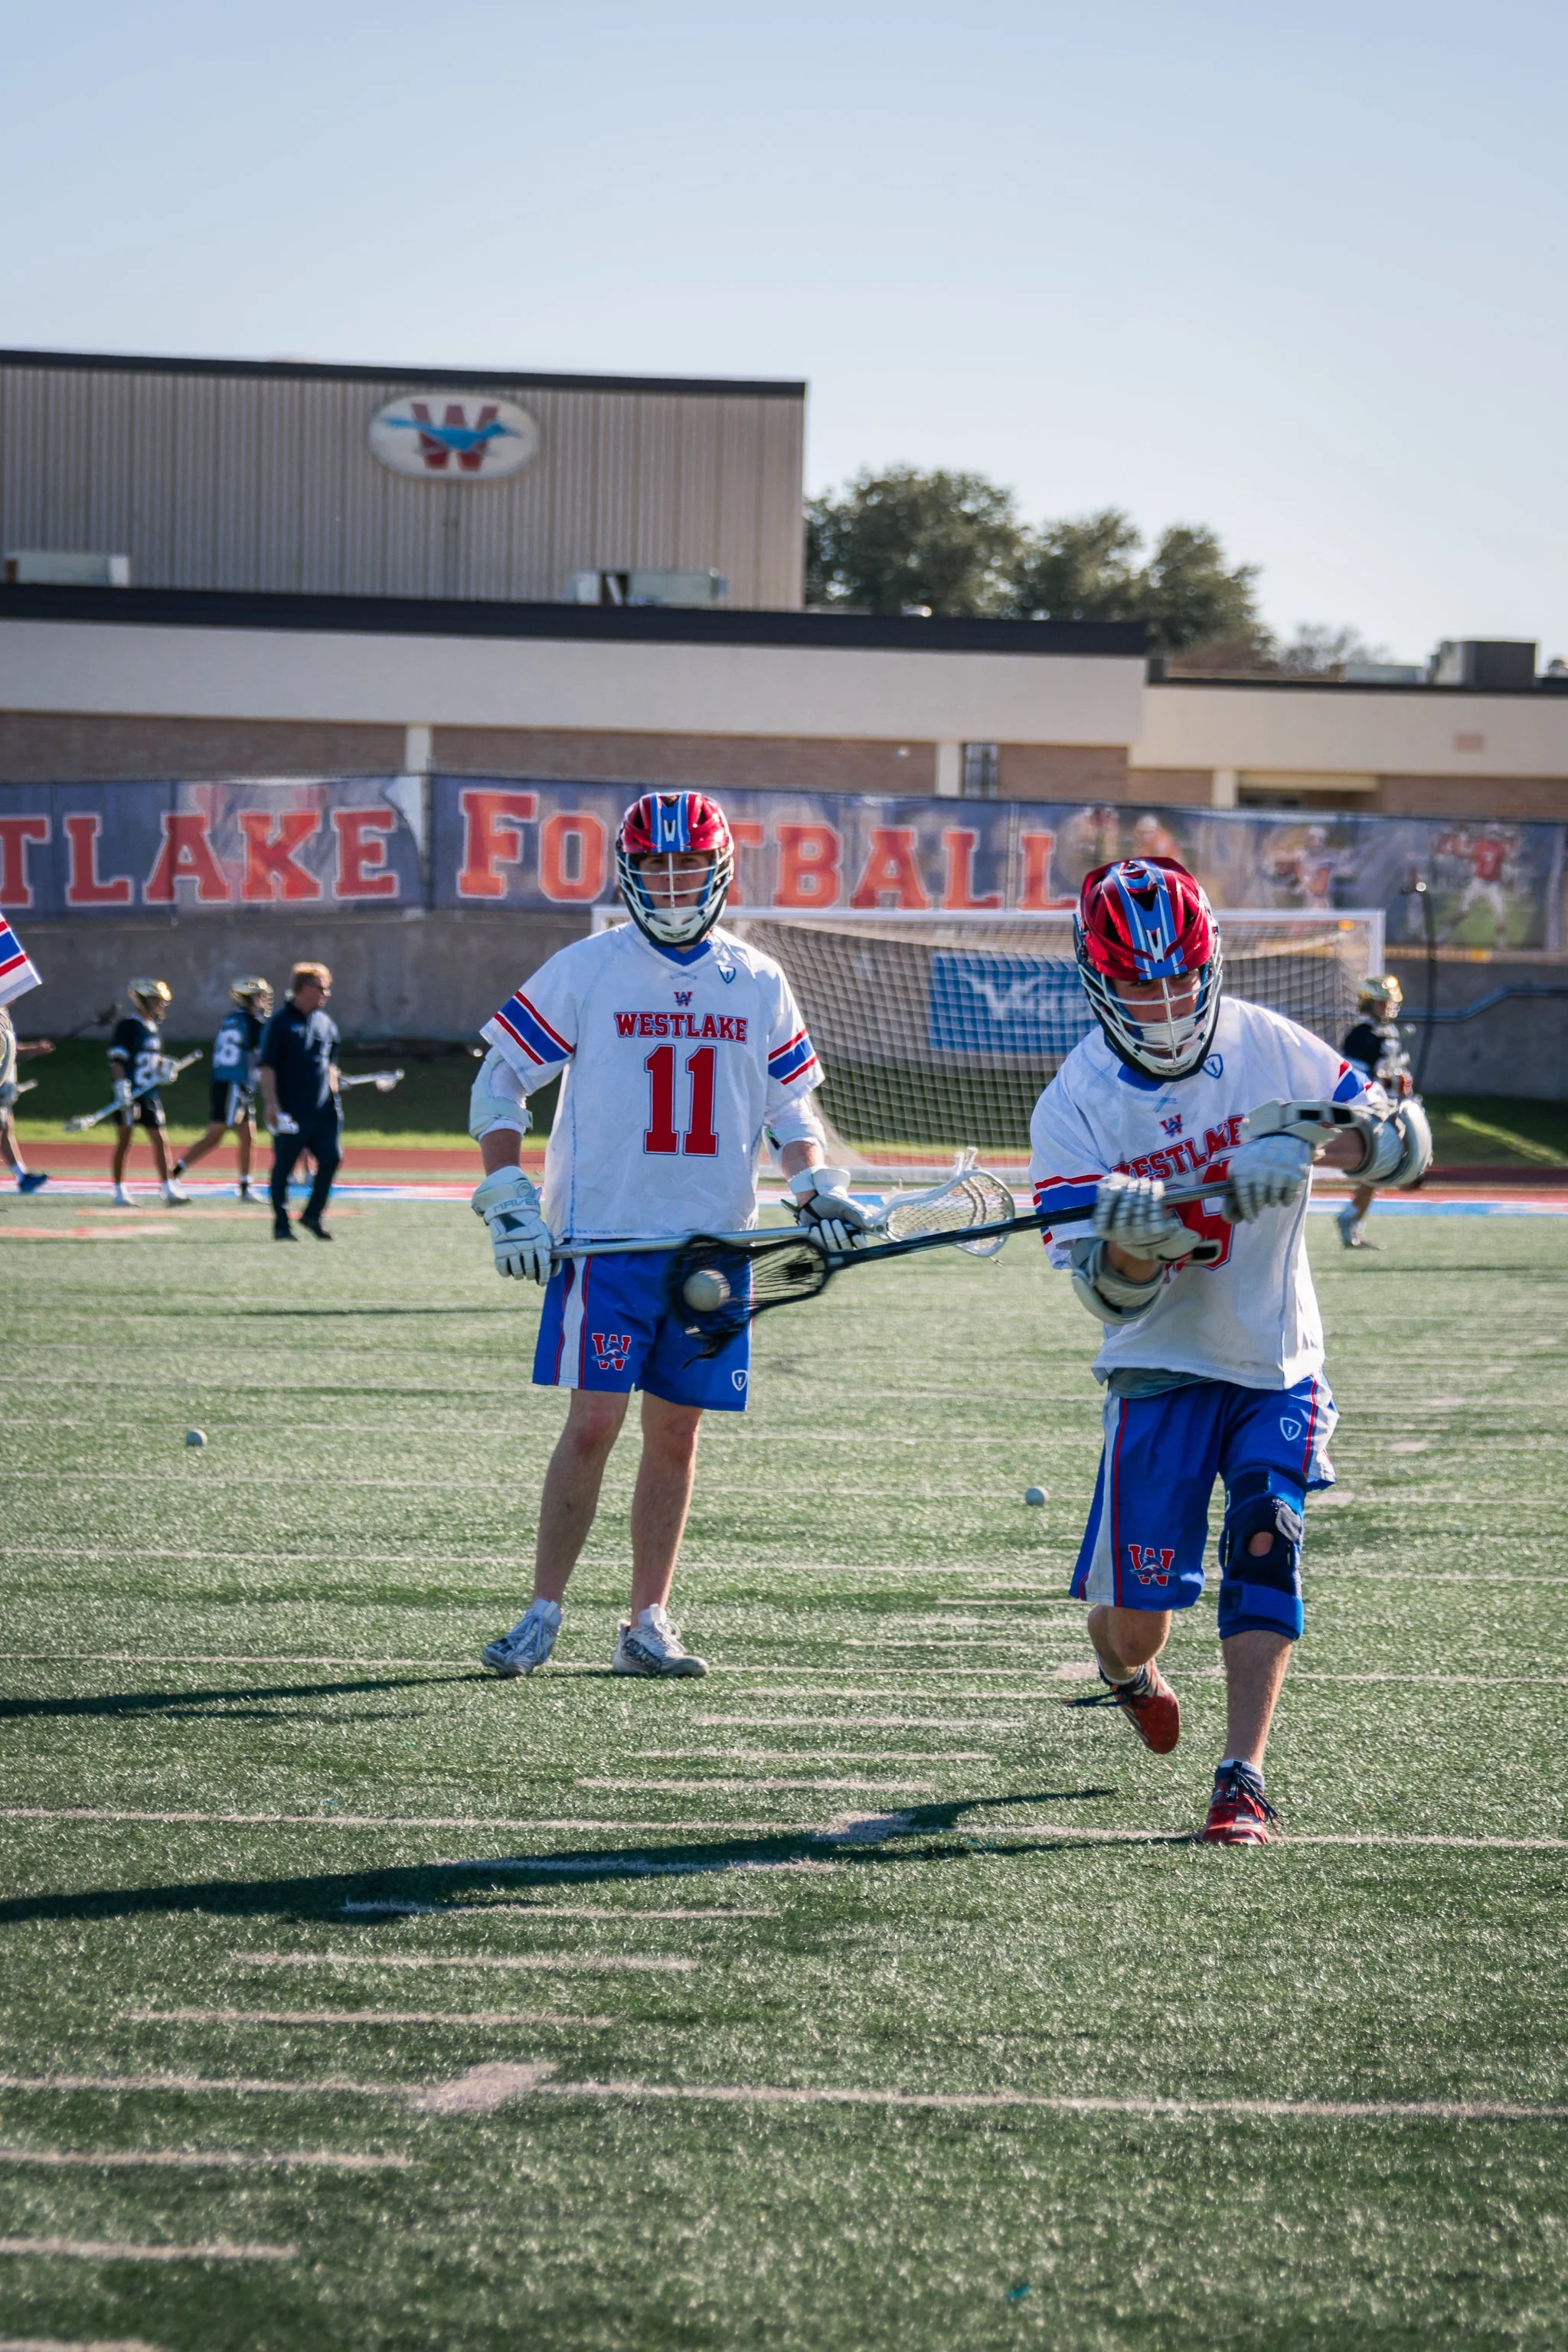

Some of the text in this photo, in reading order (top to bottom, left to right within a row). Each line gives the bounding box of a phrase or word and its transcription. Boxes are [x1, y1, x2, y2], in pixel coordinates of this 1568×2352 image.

[456, 789, 1078, 911] FOBALL
[614, 1011, 748, 1044] WESTLAKE
[644, 1044, 718, 1158] 11
[592, 1332, 632, 1371] W
[1128, 1544, 1175, 1586] W
